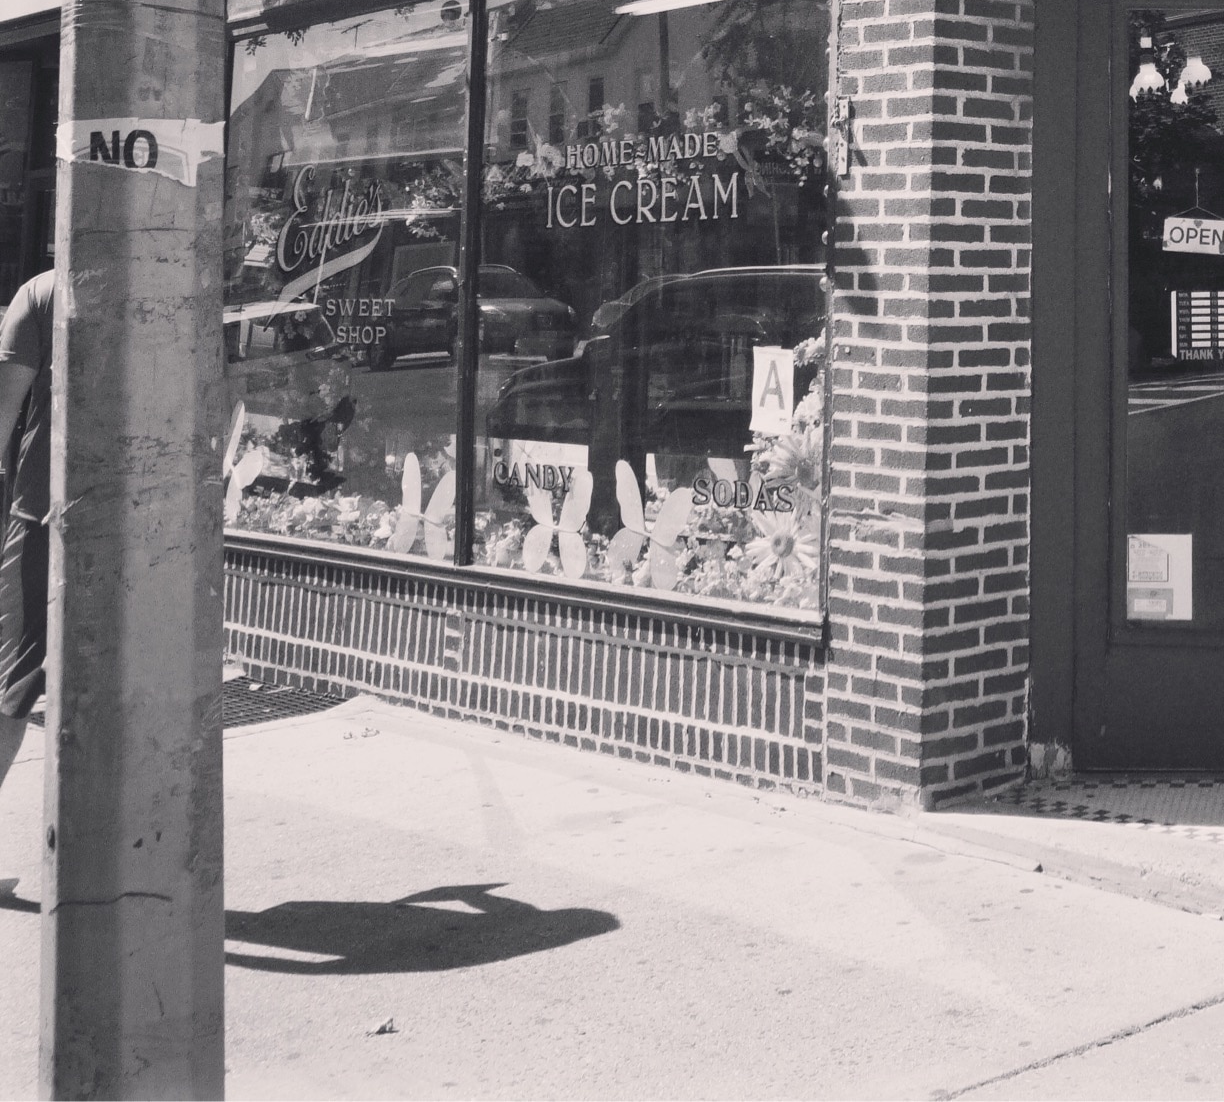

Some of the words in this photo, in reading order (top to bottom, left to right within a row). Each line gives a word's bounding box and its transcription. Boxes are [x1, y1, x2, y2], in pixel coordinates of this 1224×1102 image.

[89, 129, 158, 169] NO
[277, 165, 384, 272] Eddie's
[545, 183, 597, 230] ICE
[610, 172, 739, 226] CREAM
[325, 298, 396, 317] SWEET
[336, 326, 387, 345] SHOP
[1179, 349, 1214, 360] THANK
[758, 359, 786, 410] A
[493, 460, 575, 493] CANDY
[691, 477, 797, 513] SODAS
